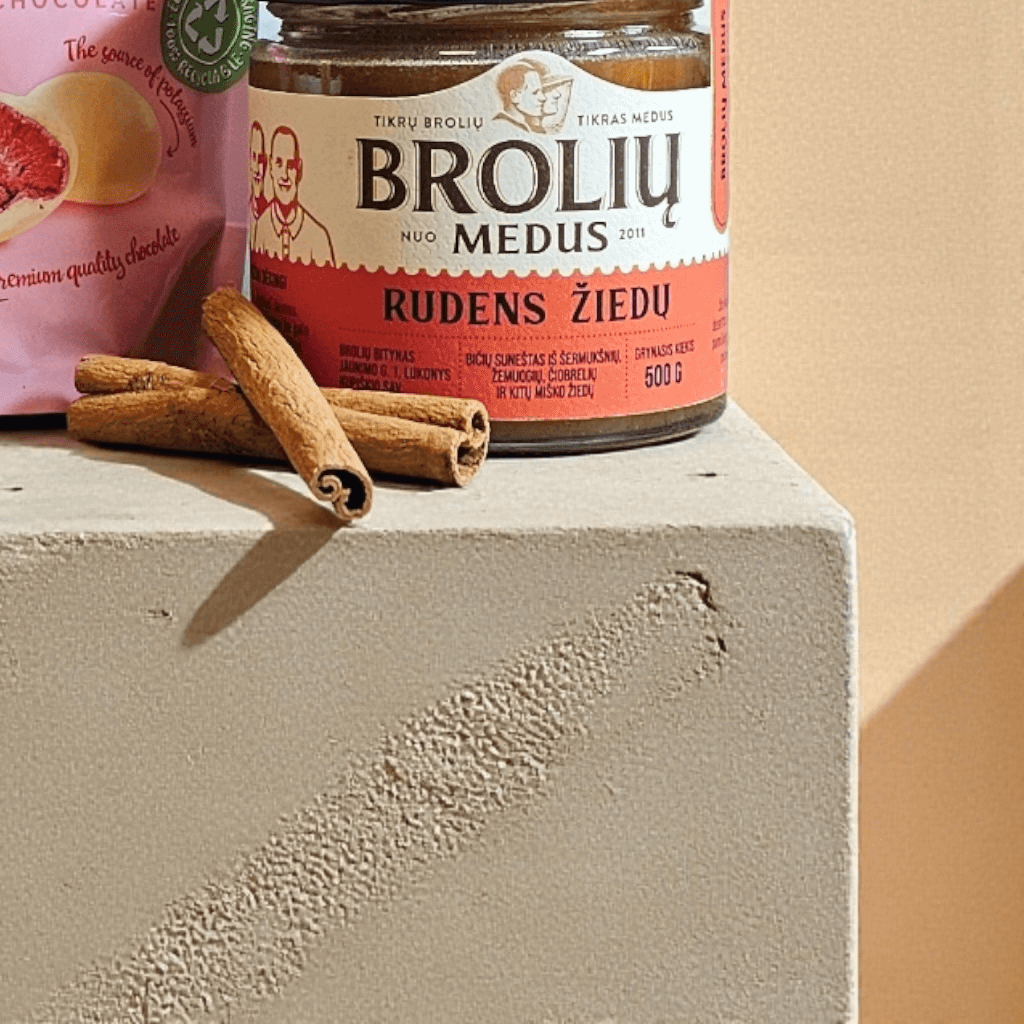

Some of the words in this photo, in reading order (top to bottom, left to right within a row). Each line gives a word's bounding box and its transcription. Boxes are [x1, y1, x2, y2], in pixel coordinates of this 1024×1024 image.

[63, 35, 98, 62] The
[101, 46, 145, 71] source
[144, 65, 162, 89] of
[374, 115, 418, 130] TIKRŲ
[424, 114, 484, 130] BROLIŲ
[577, 112, 627, 127] TIKRAS
[632, 109, 674, 124] MEDUS
[356, 132, 682, 228] BROLIŲ
[401, 230, 437, 243] NUO
[452, 220, 609, 255] MEDUS
[619, 227, 646, 240] 2011
[66, 249, 126, 287] quality
[125, 225, 180, 266] chocolate
[382, 287, 546, 326] RUDENS
[570, 282, 672, 324] ŽIEDŲ
[495, 351, 546, 367] SUNEŠTAS
[548, 351, 557, 365] IŠ
[644, 363, 672, 389] 500
[674, 361, 683, 383] G
[496, 385, 506, 398] IR
[509, 384, 532, 401] KITŲ
[535, 383, 566, 399] MIŠKO
[567, 383, 595, 399] ŽIEDŲ
